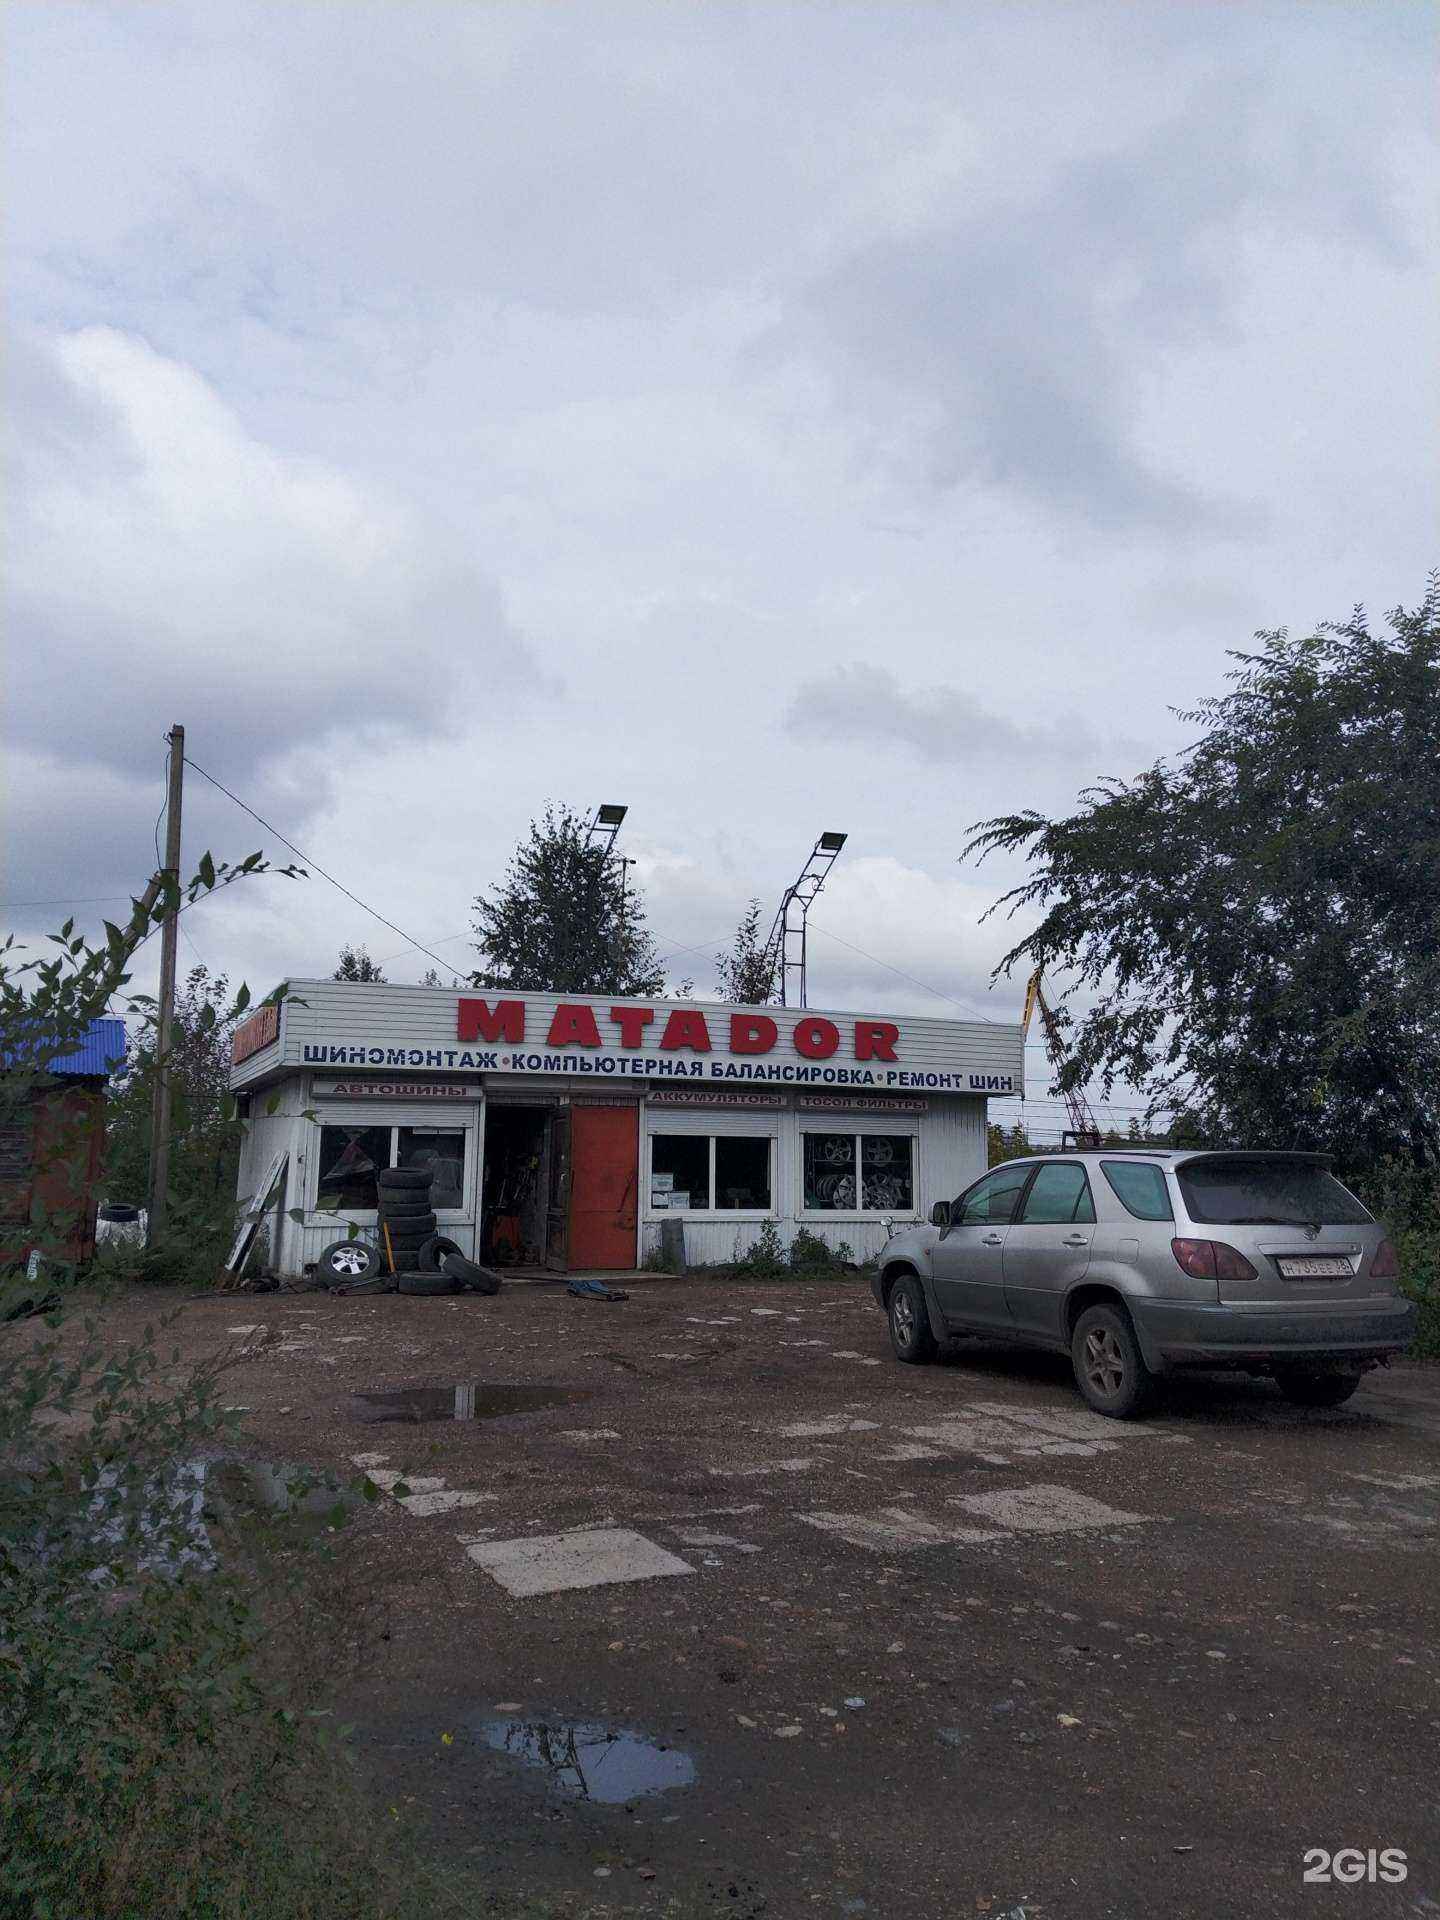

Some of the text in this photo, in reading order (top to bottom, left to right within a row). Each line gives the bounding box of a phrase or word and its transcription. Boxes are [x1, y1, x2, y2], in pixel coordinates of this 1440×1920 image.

[458, 998, 899, 1061] MATADOR
[304, 1045, 1012, 1091] ШИНОМОНТАЖ КОМПЬЮТЕРНАЯ БАЛАНСИРОВКА РЕМОНТ ШИН
[333, 1084, 467, 1096] АВТОШИНЫ
[652, 1092, 782, 1105] АККУМУЛЯТОРЫ
[856, 1098, 927, 1111] ФИЛЬТРЫ
